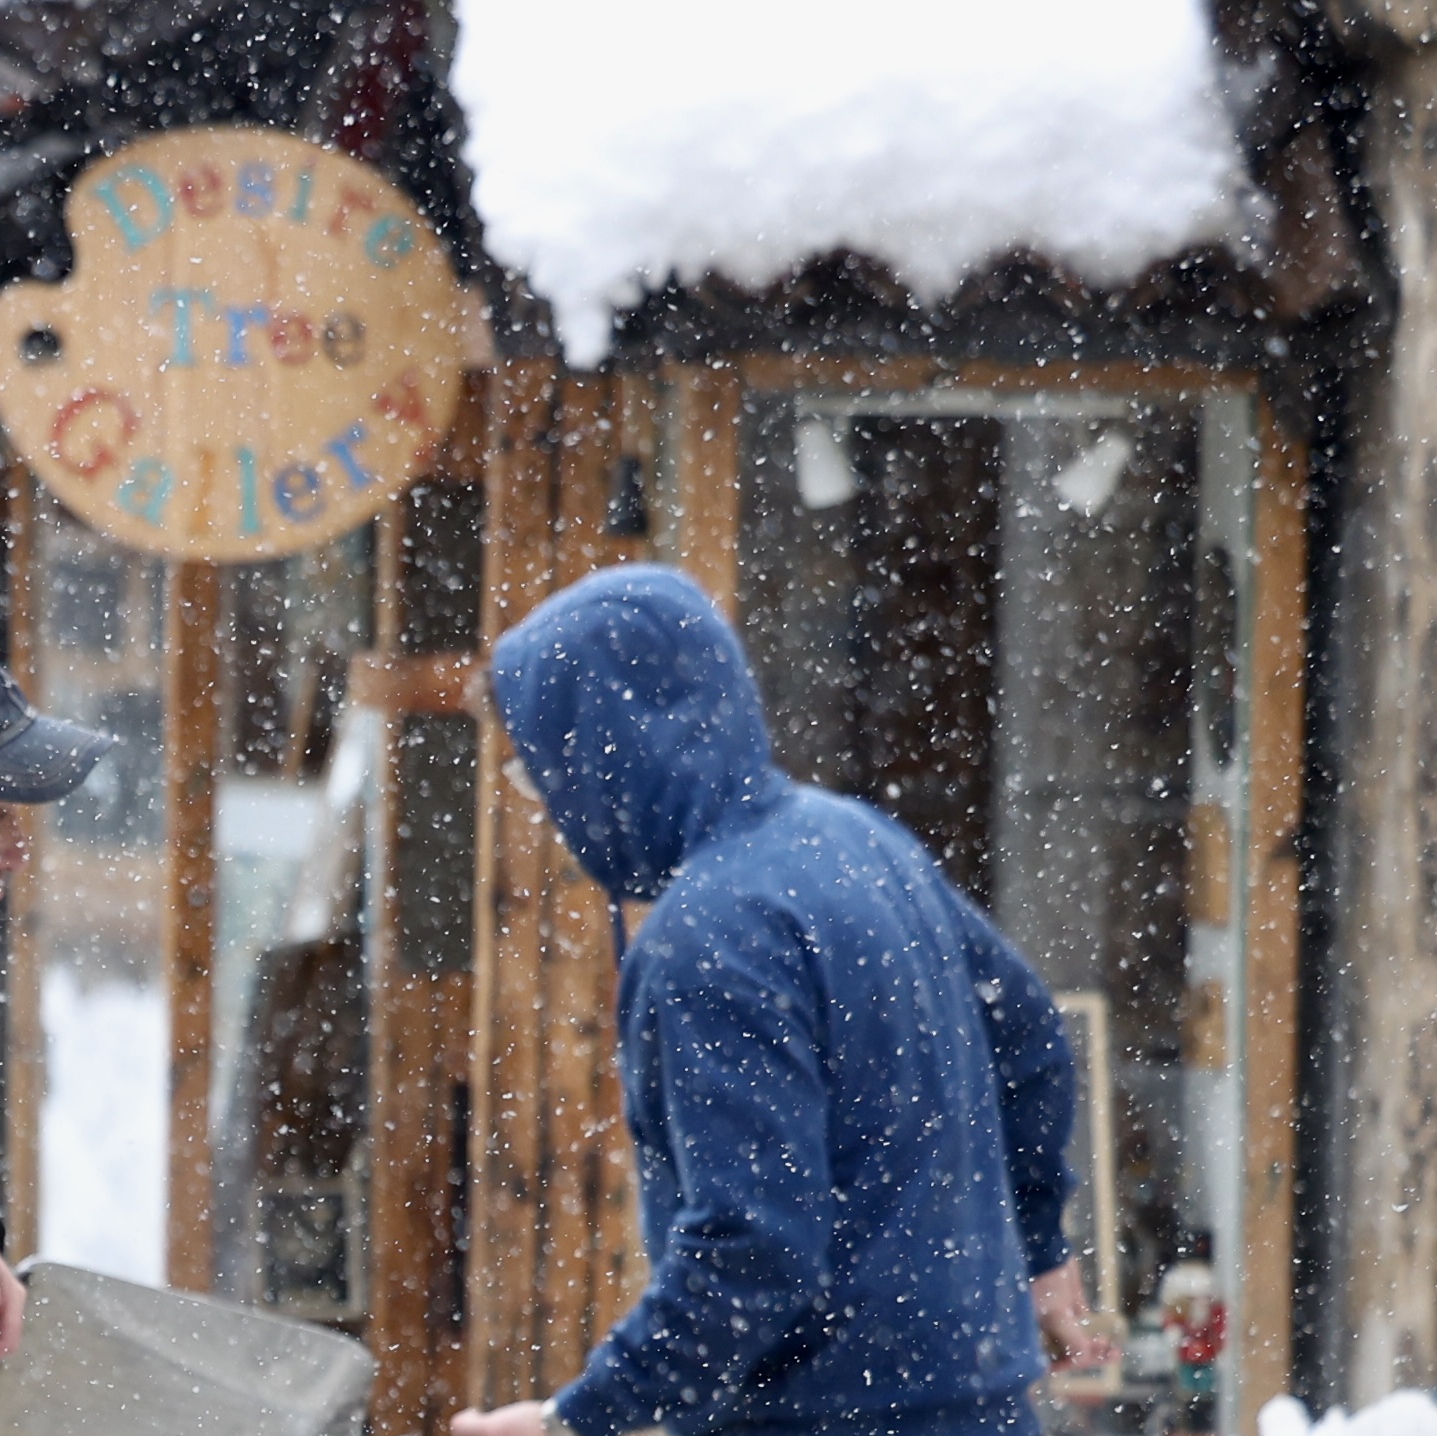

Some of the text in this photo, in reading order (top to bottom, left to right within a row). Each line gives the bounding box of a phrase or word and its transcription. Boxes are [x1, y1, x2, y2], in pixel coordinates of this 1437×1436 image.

[93, 158, 415, 268] Desire
[150, 288, 366, 366] Tree
[50, 369, 438, 534] Gallery
